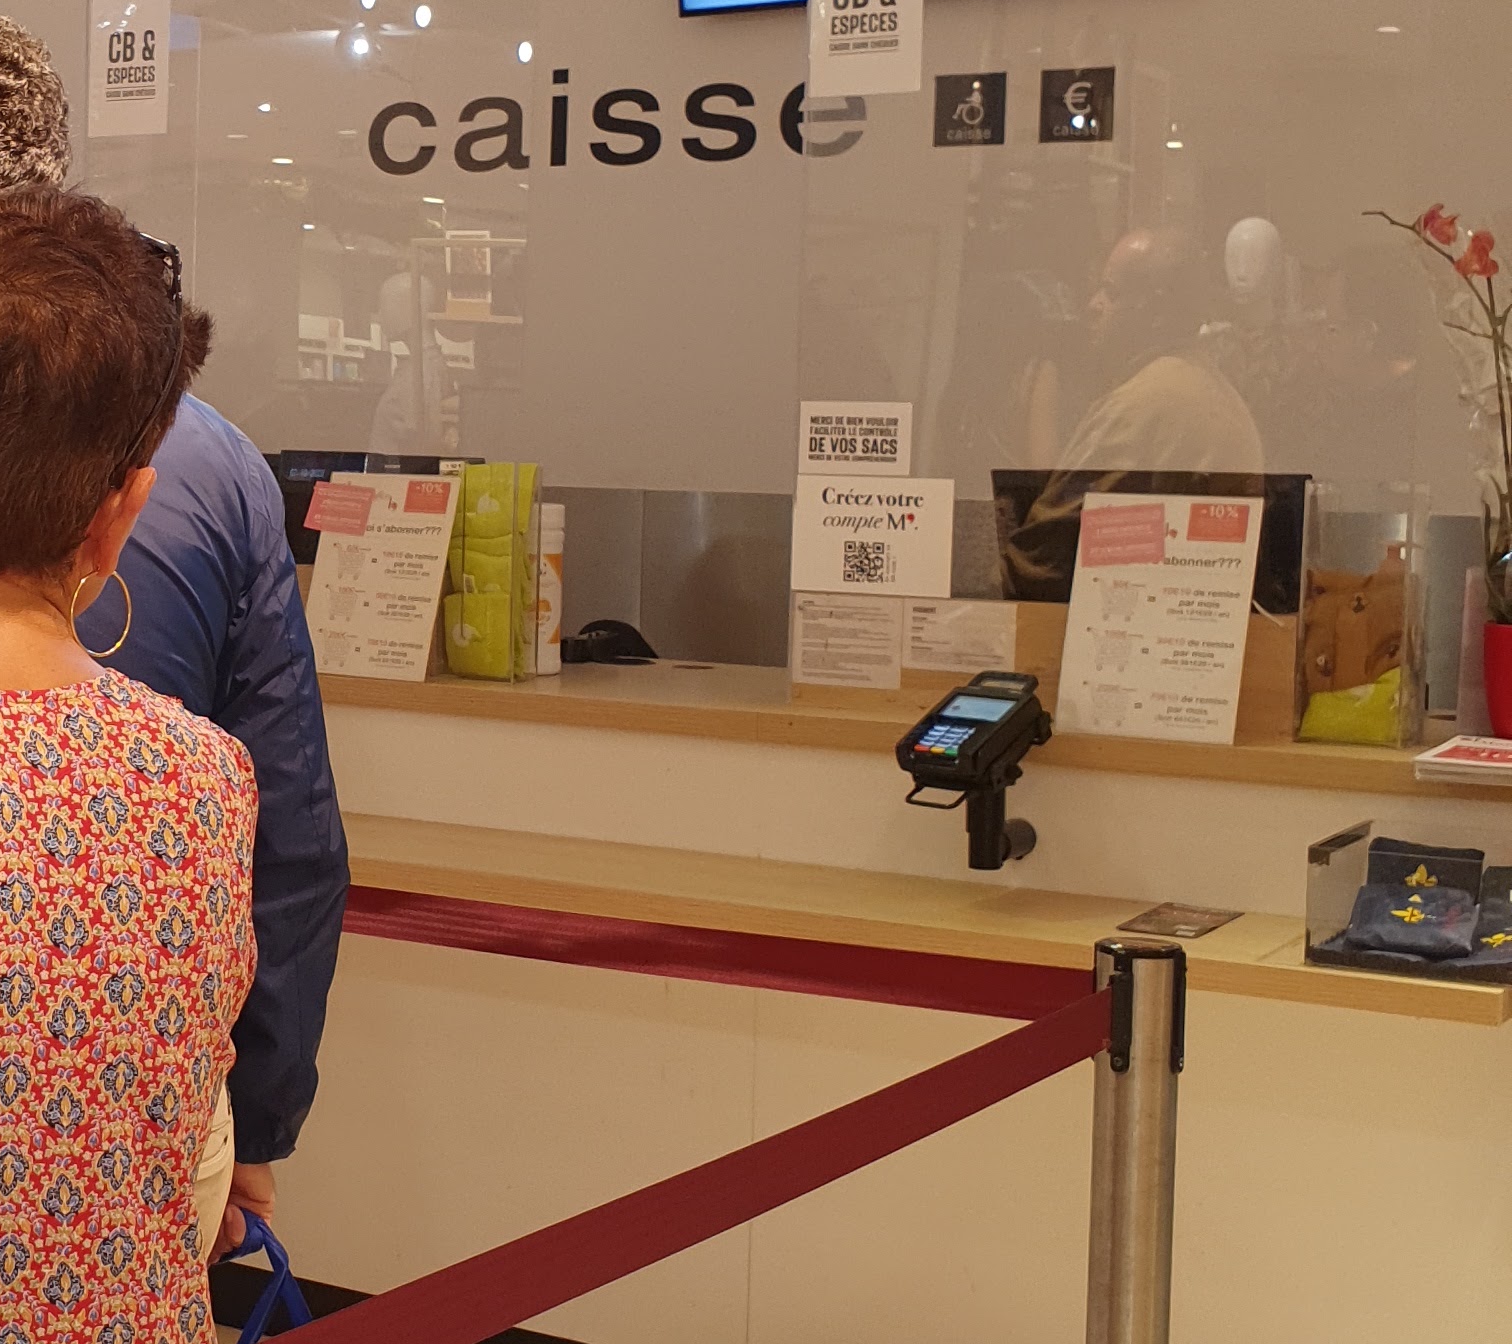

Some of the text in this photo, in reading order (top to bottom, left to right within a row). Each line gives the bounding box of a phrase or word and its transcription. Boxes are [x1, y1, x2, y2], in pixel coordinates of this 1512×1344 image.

[108, 29, 156, 64] CB &
[367, 67, 868, 176] caisse
[810, 415, 833, 426] MERCI
[809, 437, 898, 455] DE VOS SACS
[821, 486, 925, 508] Créez votre
[1200, 505, 1240, 519] -10%
[822, 513, 885, 534] compte
[1163, 556, 1242, 569] abonner???
